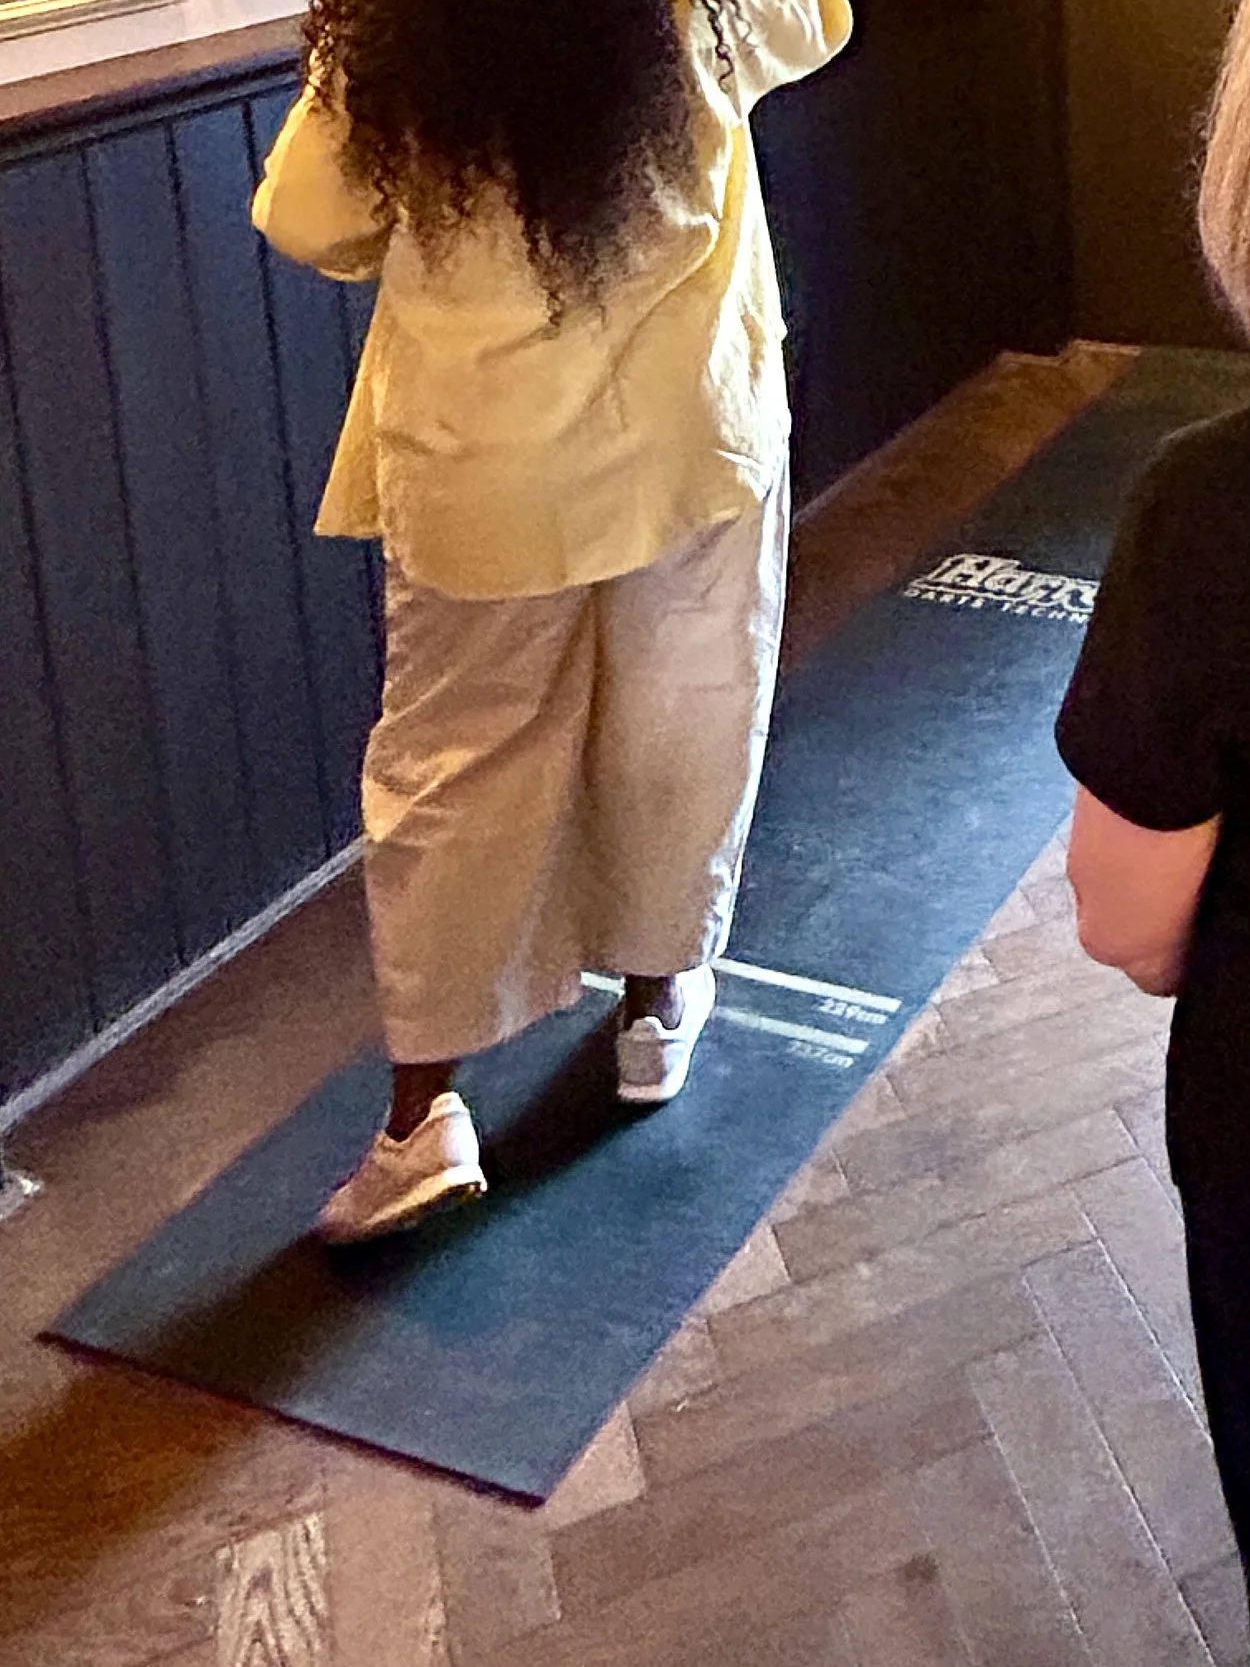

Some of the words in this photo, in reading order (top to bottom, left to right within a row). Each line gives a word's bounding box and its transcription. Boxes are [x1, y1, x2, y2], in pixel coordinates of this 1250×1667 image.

[902, 588, 985, 609] DARTS
[1000, 601, 1091, 624] TECHN
[922, 553, 1101, 612] Harr
